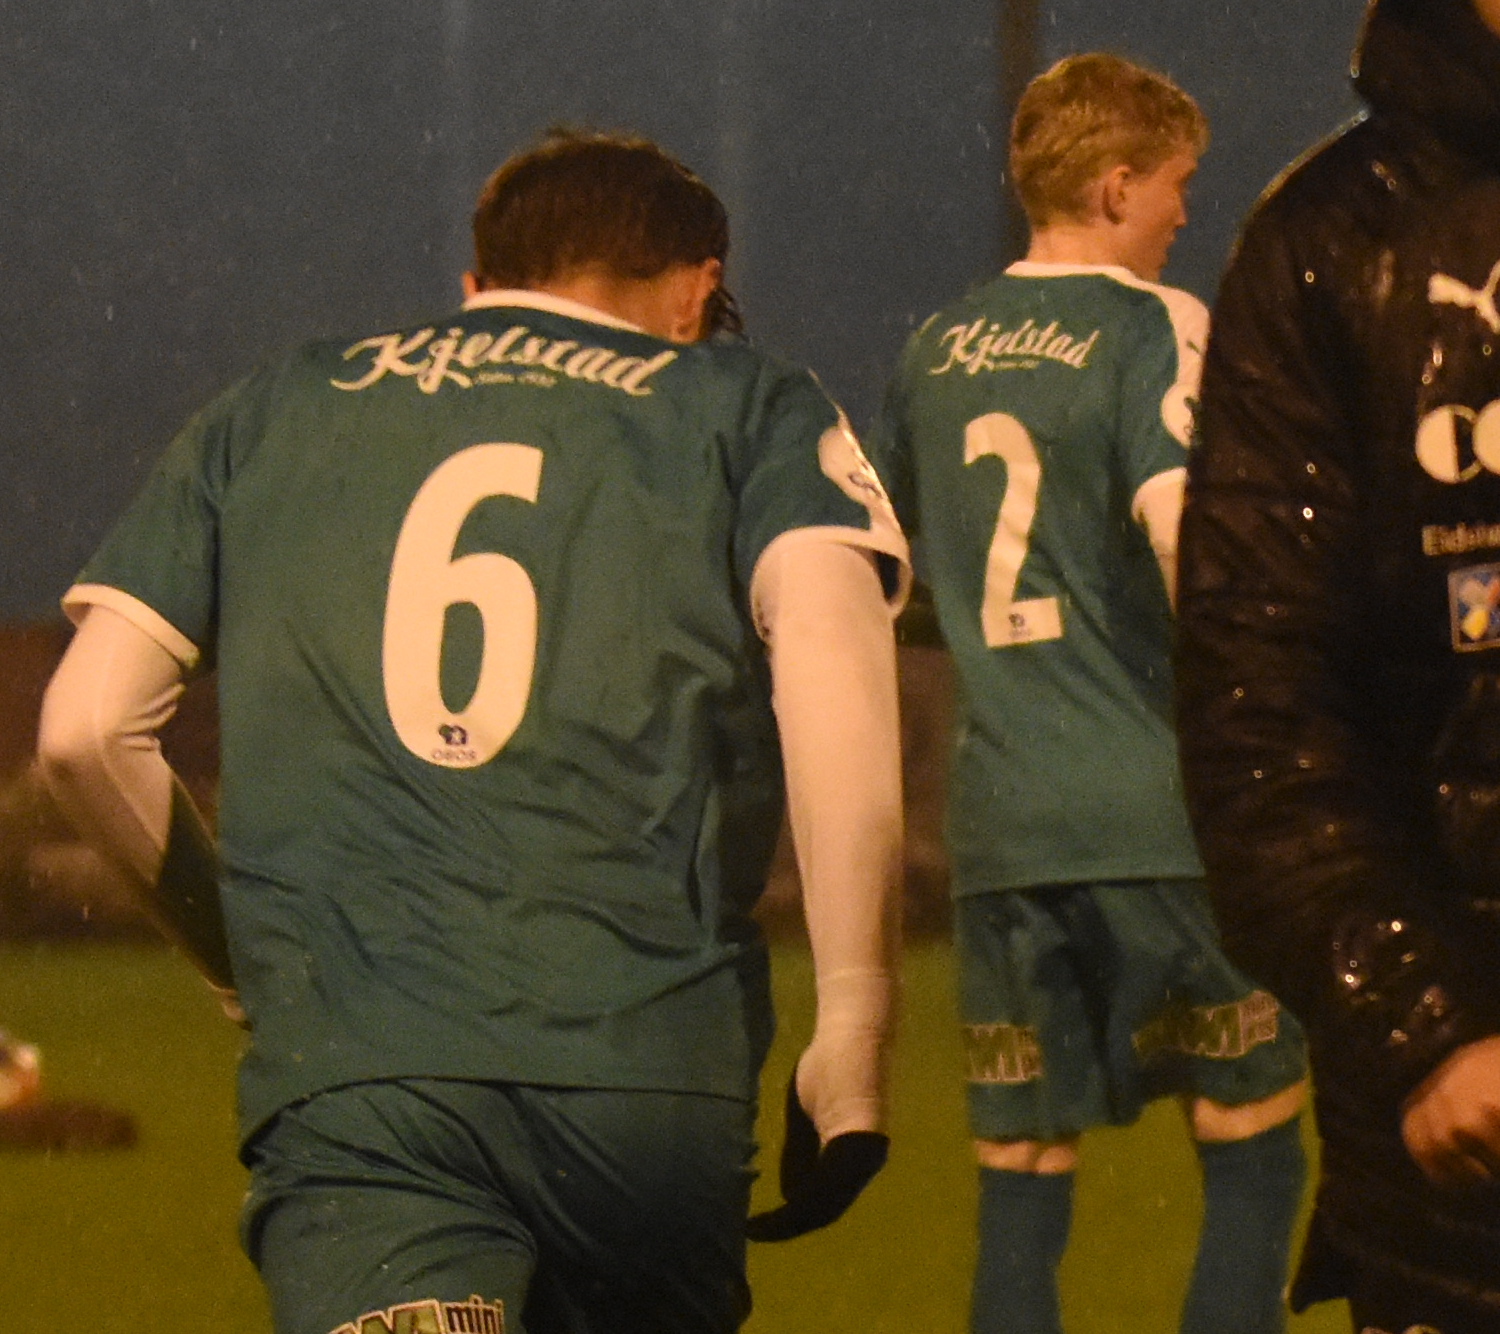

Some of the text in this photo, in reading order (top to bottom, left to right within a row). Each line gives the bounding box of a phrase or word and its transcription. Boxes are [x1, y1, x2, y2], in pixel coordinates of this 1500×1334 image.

[927, 316, 1100, 375] Kjelstad
[382, 442, 543, 769] 6
[963, 412, 1062, 648] 2
